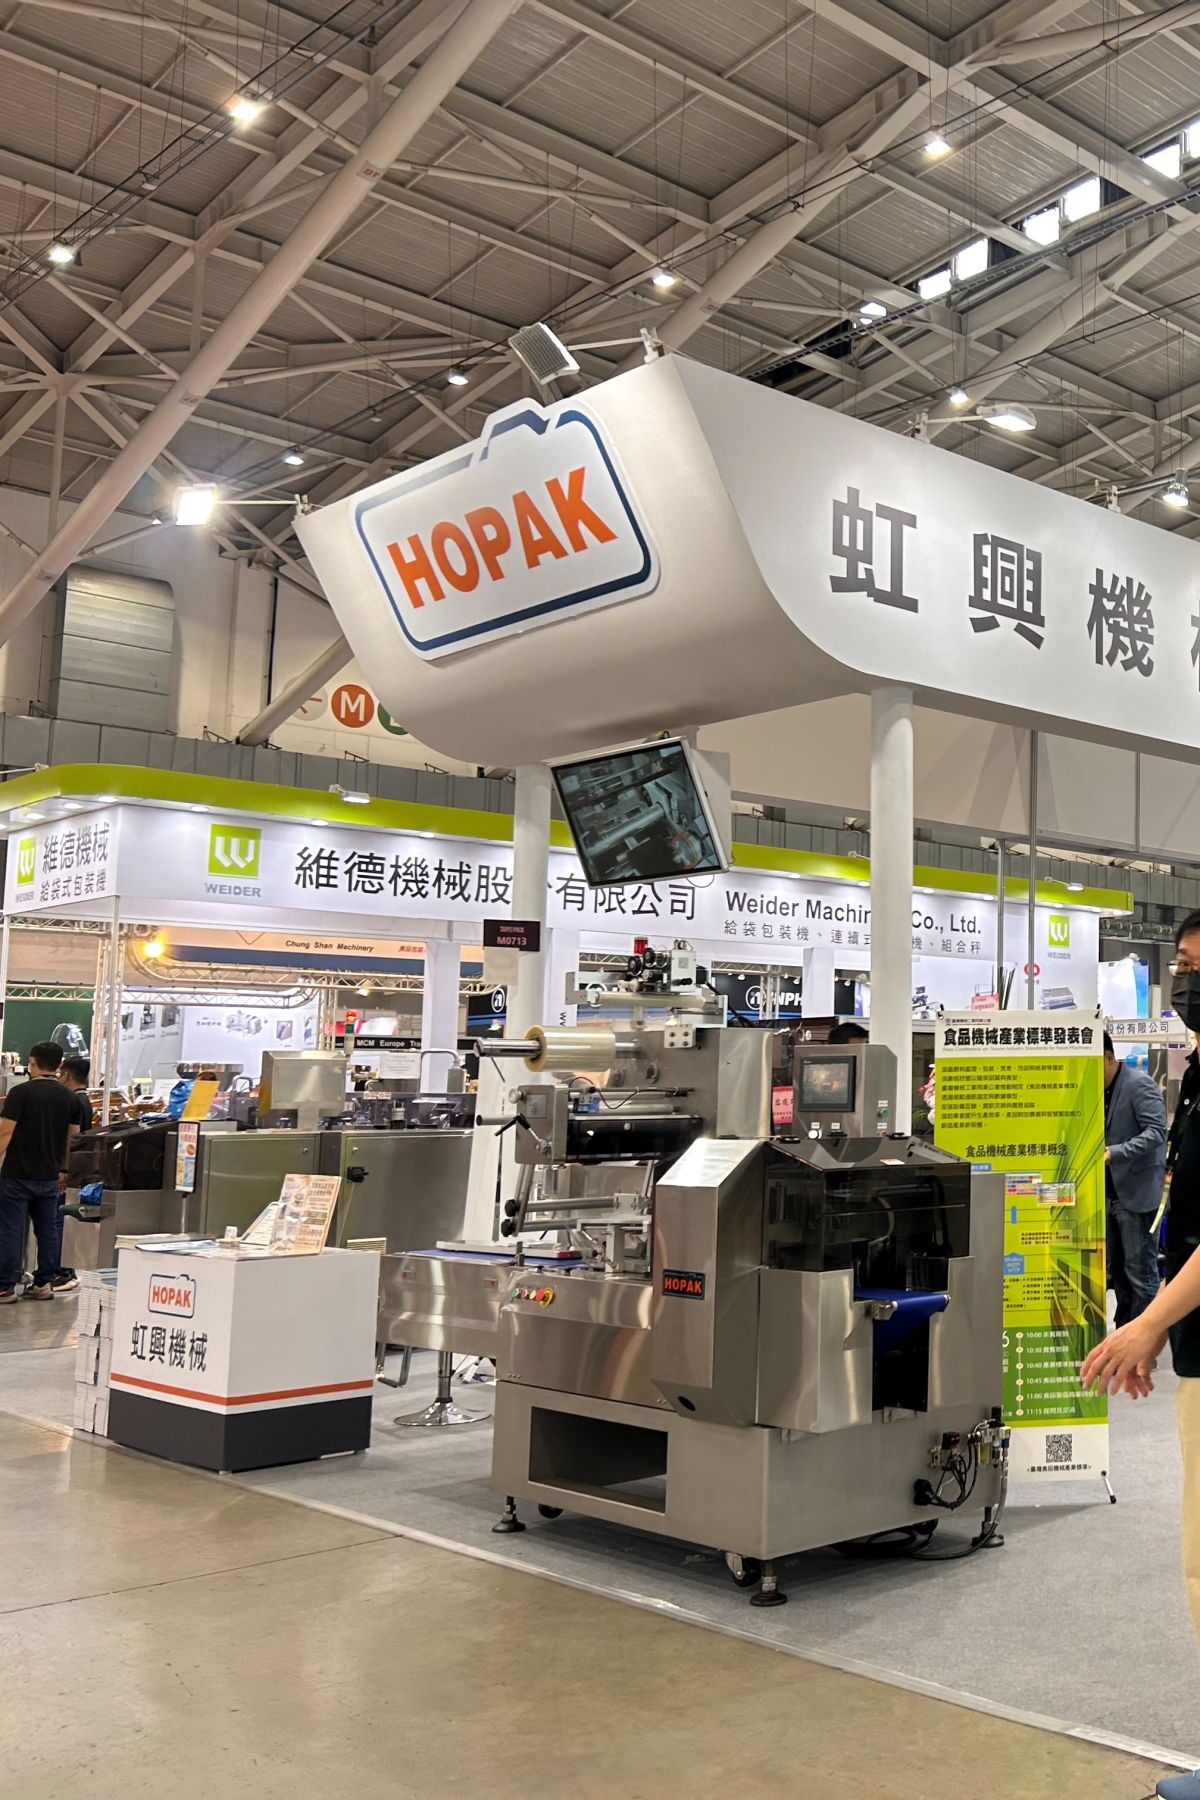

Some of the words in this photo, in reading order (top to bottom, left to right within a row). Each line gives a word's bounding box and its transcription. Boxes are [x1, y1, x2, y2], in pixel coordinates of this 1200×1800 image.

[386, 467, 618, 609] HOPAK
[340, 691, 366, 722] M
[43, 822, 110, 874] 維德機械
[39, 868, 107, 902] 給袋式包裝機
[204, 881, 262, 898] WEIDER
[295, 846, 697, 921] 維德機械股有限公司
[726, 890, 800, 917] Weider
[806, 899, 871, 924] Machin
[912, 911, 944, 934] Co.,
[950, 914, 982, 934] Ltd.
[285, 940, 310, 950] Chung
[314, 941, 333, 950] Shan
[337, 943, 374, 953] Machinery
[497, 936, 527, 945] M0713
[1047, 951, 1071, 960] WEIDER
[356, 1039, 375, 1047] MCM
[379, 1040, 405, 1049] Europe
[410, 1040, 421, 1048] Tra
[944, 1027, 1094, 1046] 食品機械產業標準發表會
[965, 1143, 1068, 1159] 食品機械產業標準概念
[664, 1277, 702, 1293] HOPAK
[152, 1285, 192, 1309] HOPAK
[130, 1321, 208, 1373] 虹興機械
